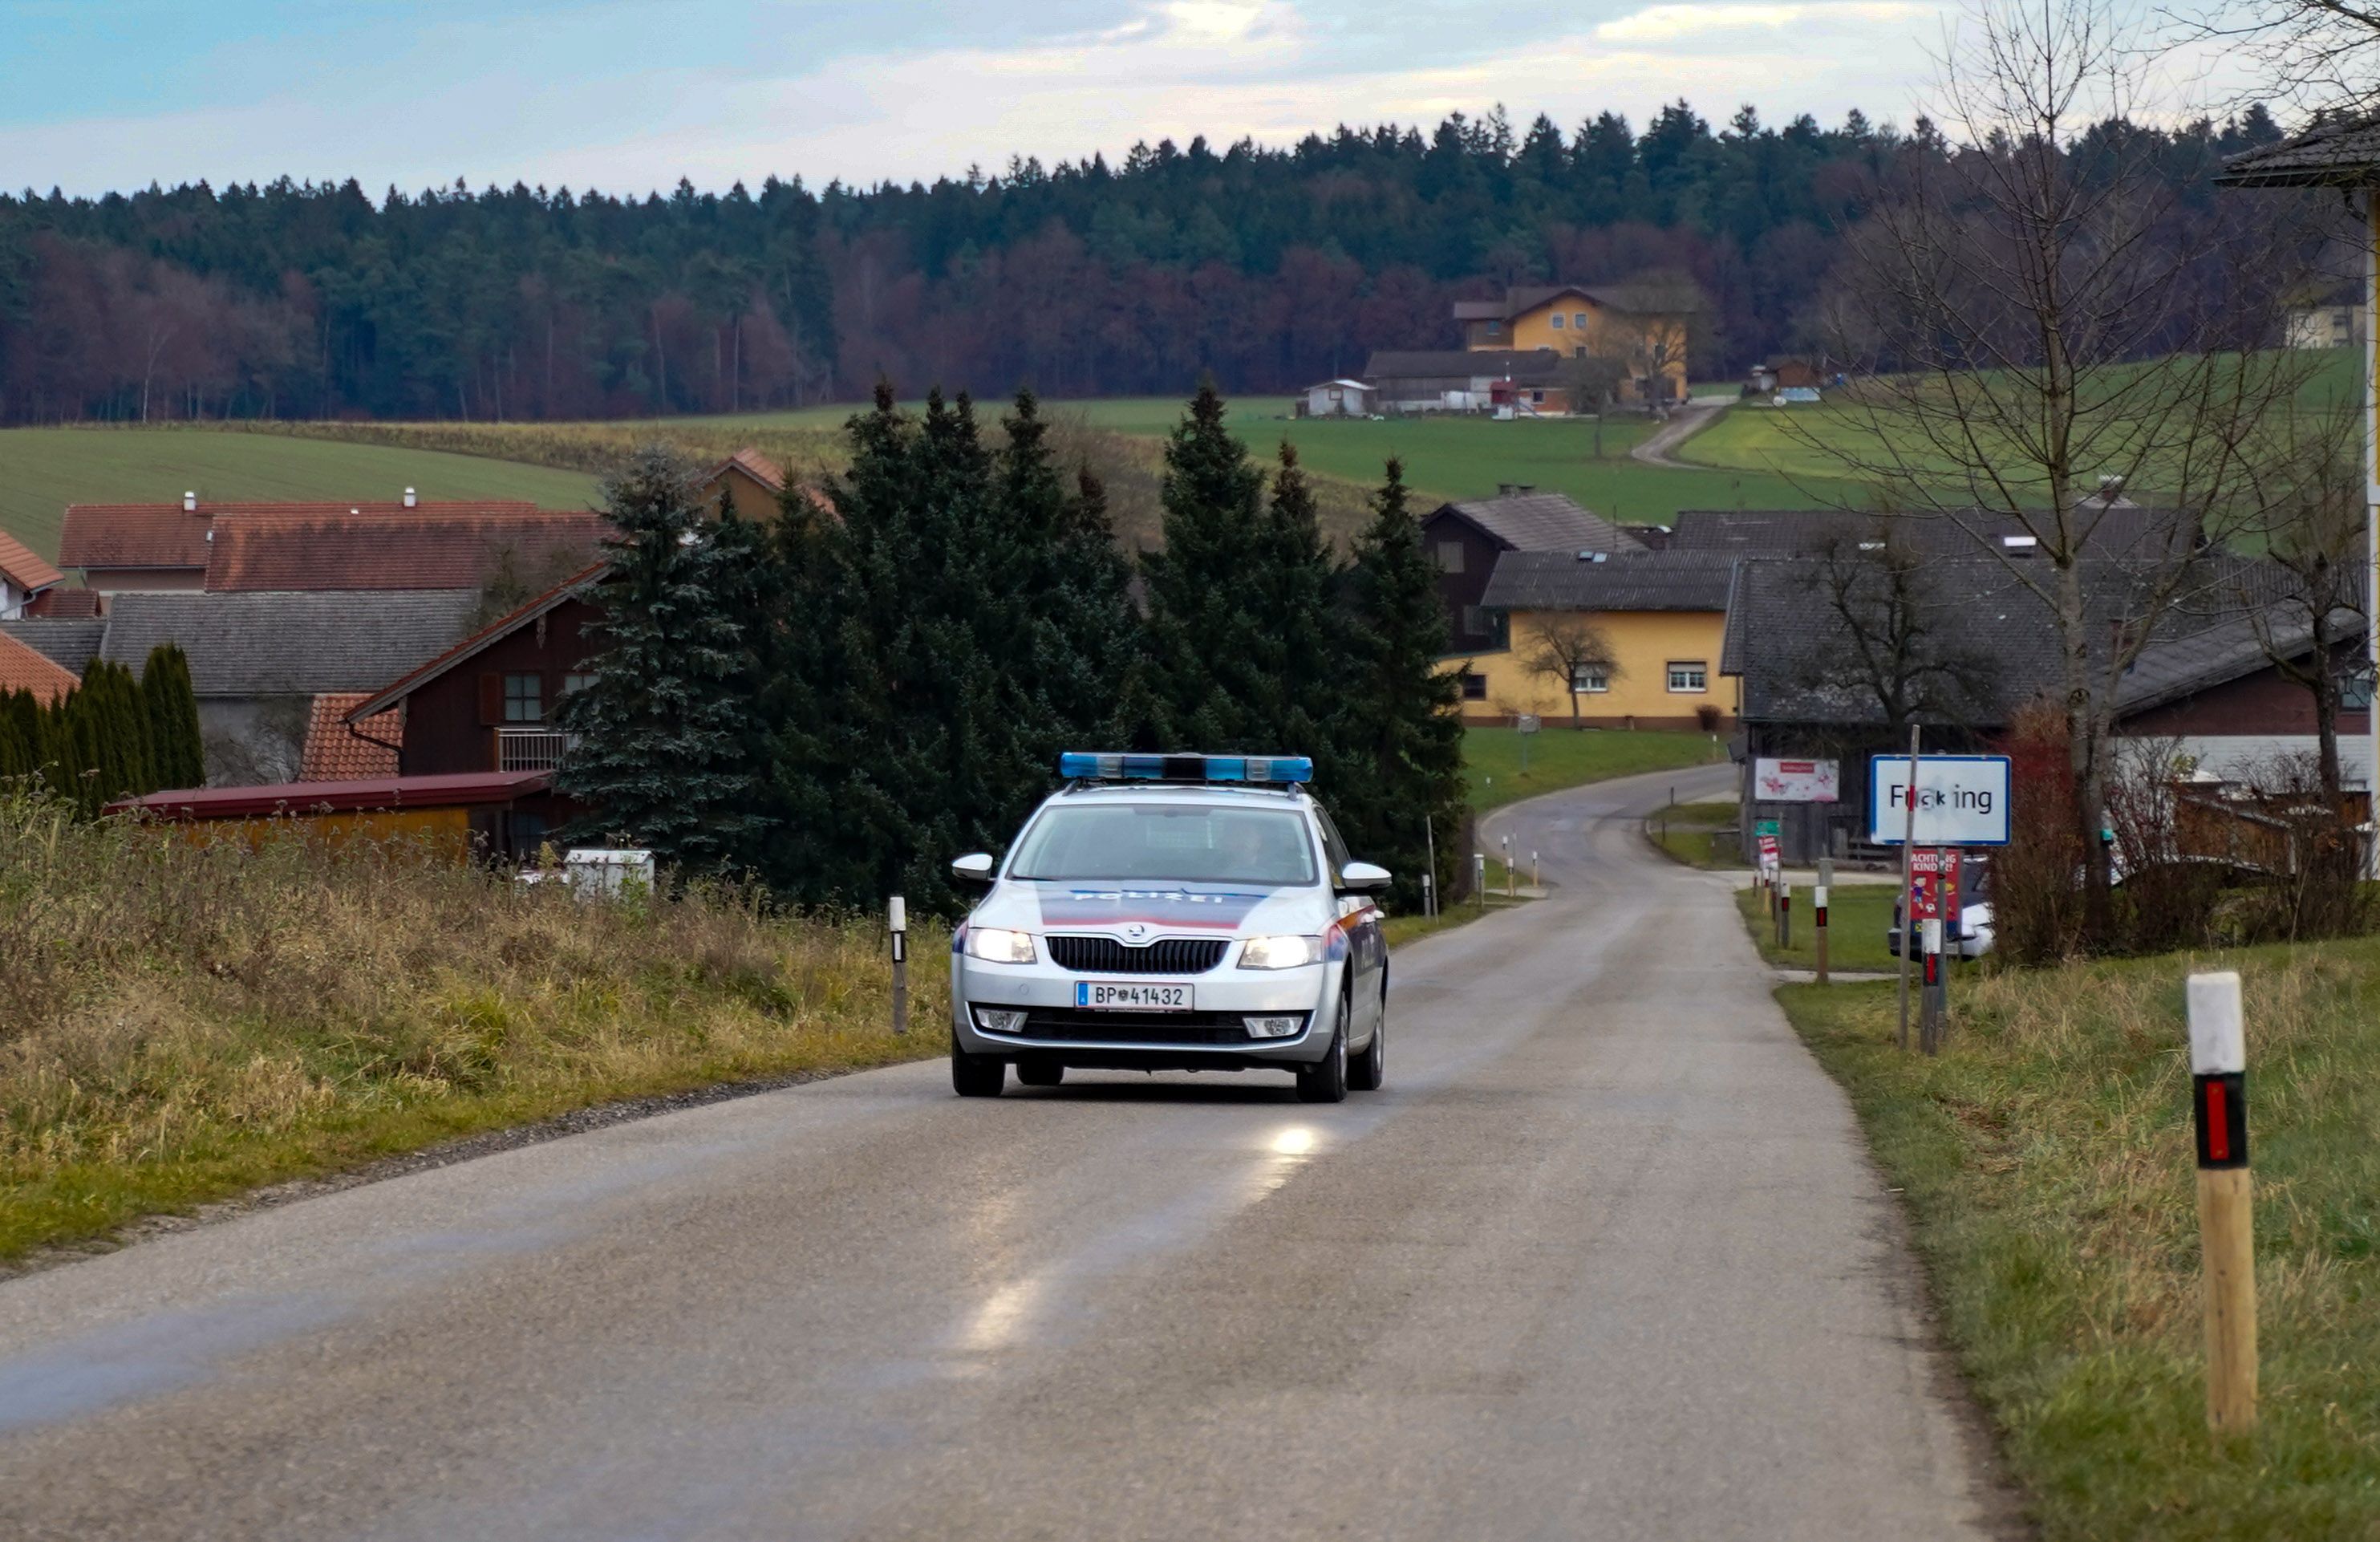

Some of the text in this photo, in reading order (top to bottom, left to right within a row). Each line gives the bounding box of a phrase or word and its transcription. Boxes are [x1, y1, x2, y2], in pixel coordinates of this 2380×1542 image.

[1913, 862, 1953, 872] KINDR!
[1074, 891, 1222, 903] POLIZEI
[1096, 987, 1183, 1005] BP 41432
